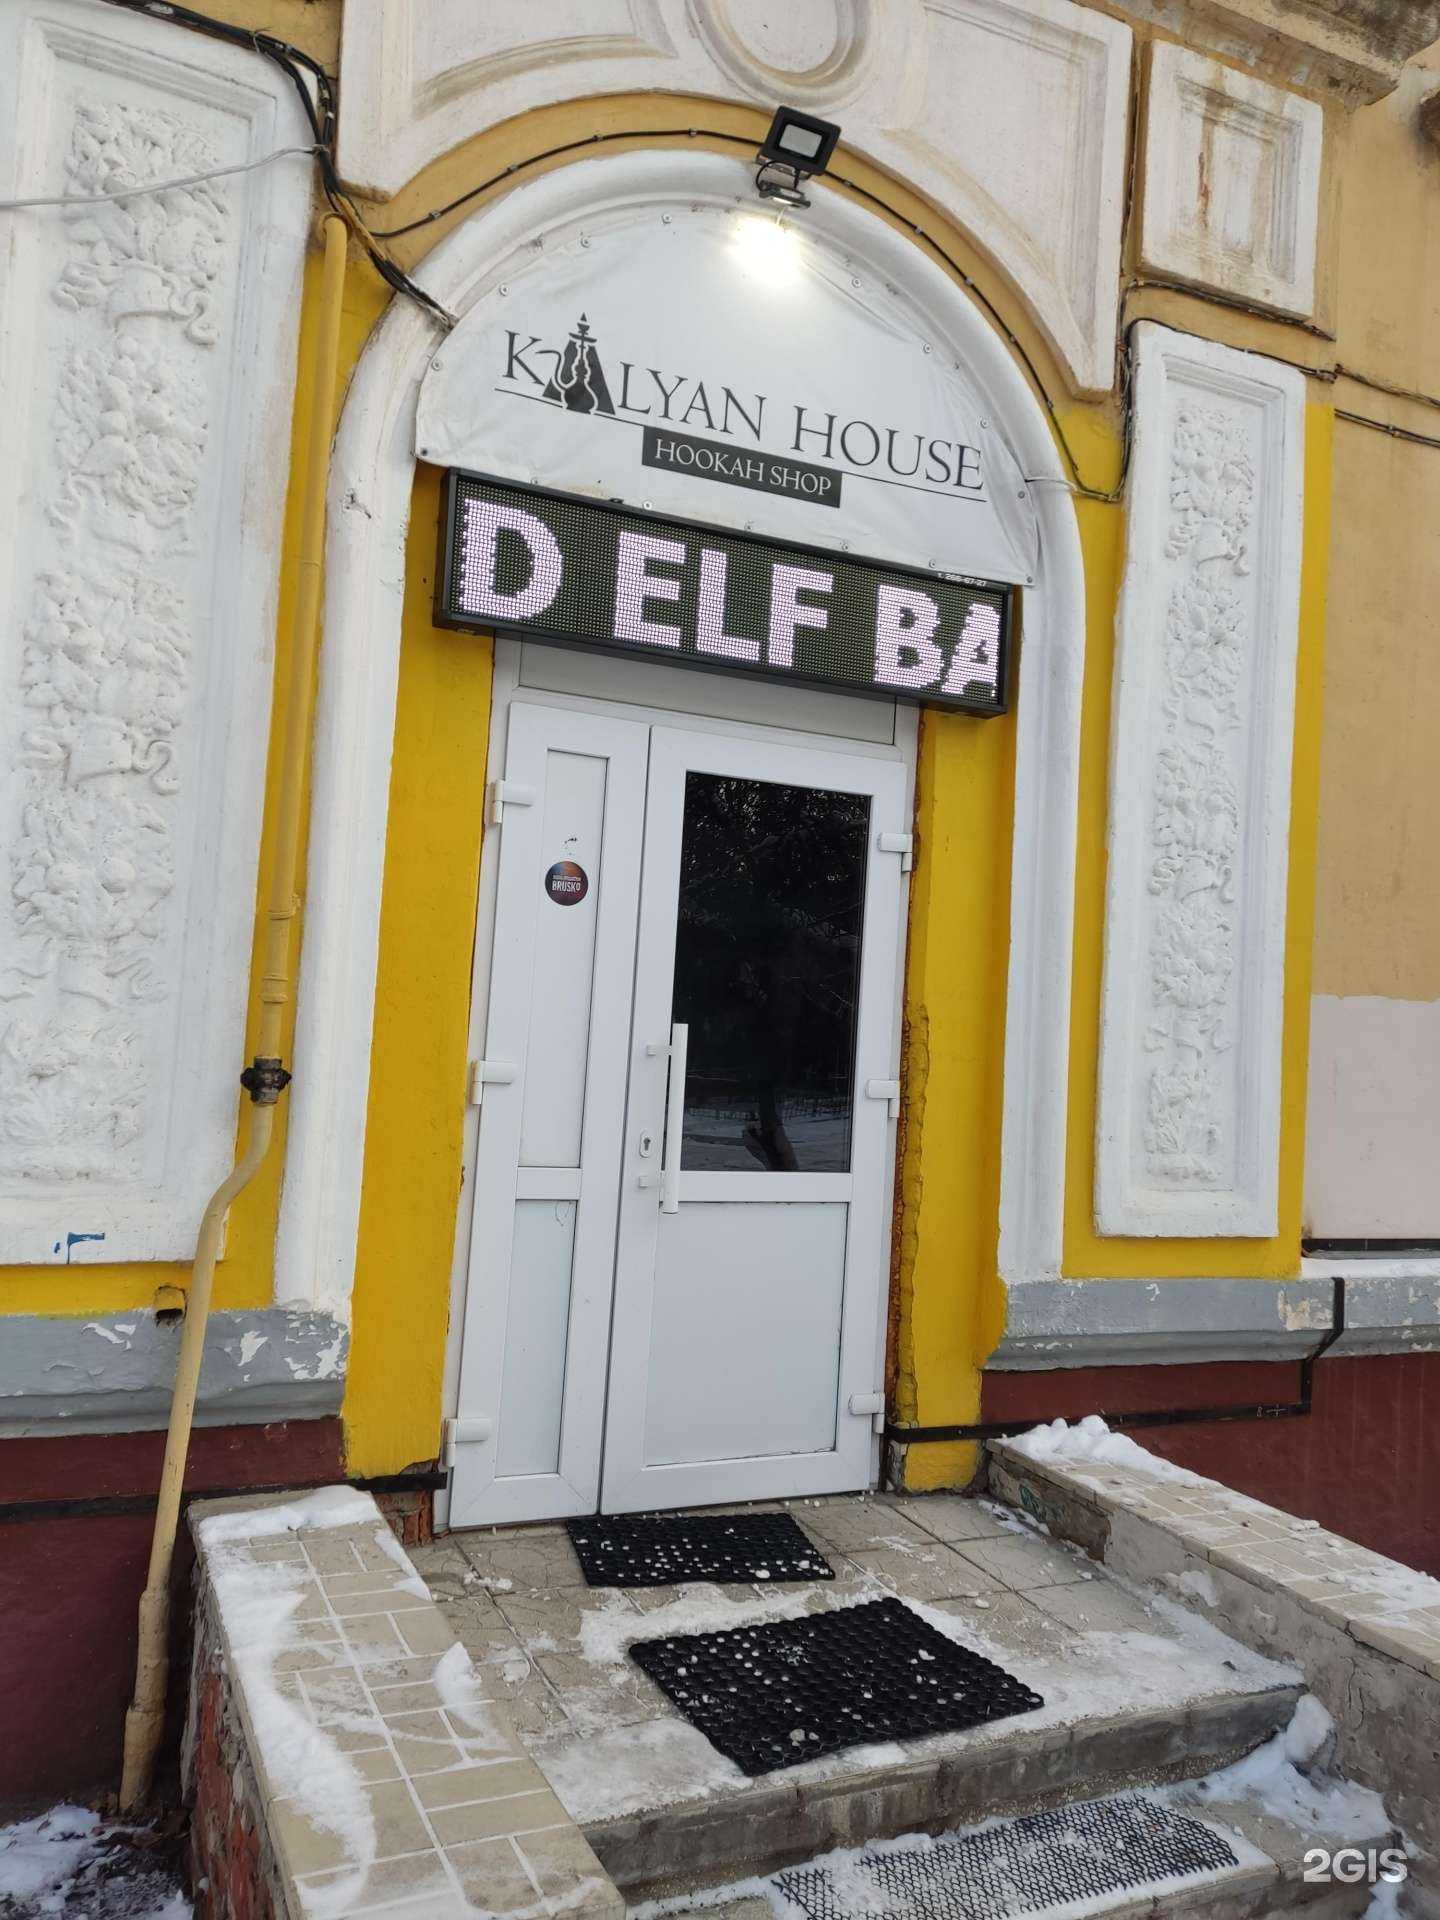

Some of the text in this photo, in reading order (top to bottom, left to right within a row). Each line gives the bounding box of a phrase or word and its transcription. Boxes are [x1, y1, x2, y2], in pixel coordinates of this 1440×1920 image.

[501, 313, 984, 491] KALYAN HOUSE
[654, 438, 832, 496] HOOKAH SHOP
[459, 498, 1001, 697] D ELF BA
